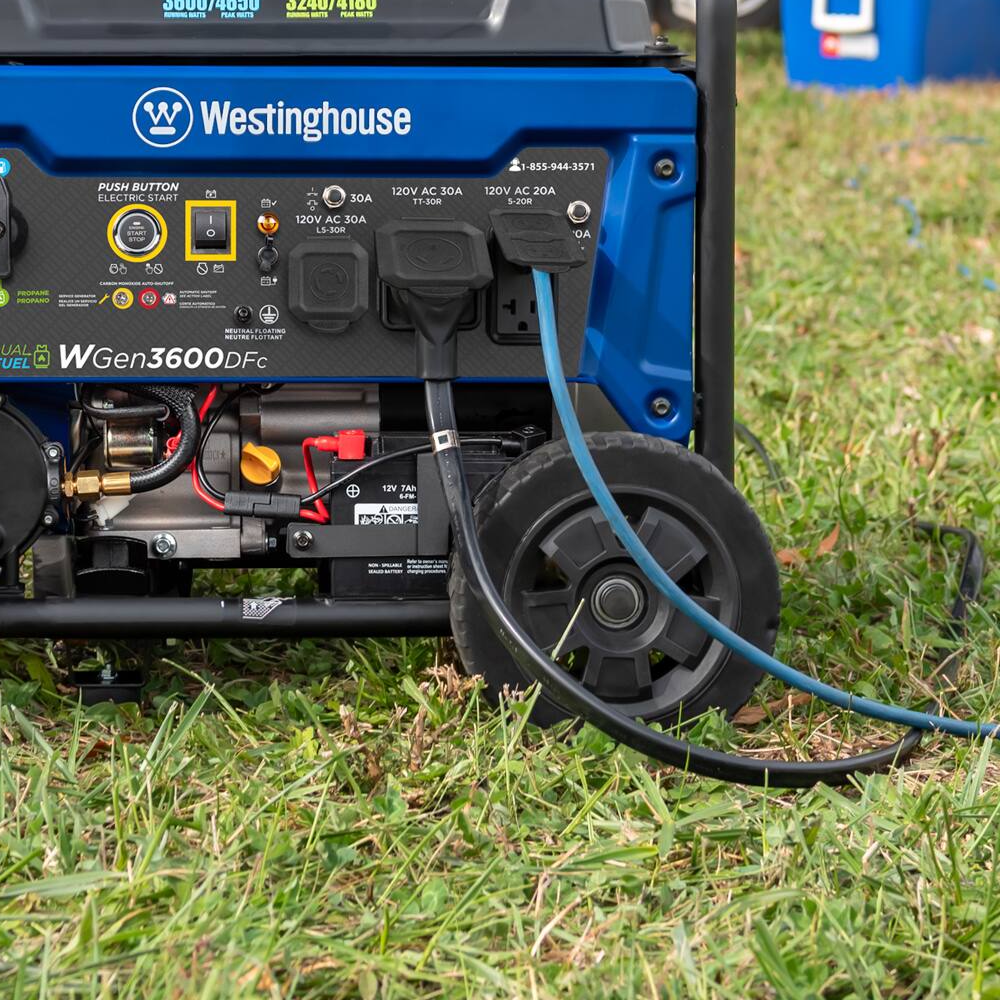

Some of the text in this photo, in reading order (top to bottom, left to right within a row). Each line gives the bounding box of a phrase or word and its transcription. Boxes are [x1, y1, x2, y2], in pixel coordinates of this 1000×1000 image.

[163, 11, 206, 19] RUNNING WATTS
[221, 11, 255, 19] PEAK WATTS
[199, 100, 412, 142] Westinghouse
[520, 162, 595, 171] 1-855-944-3571
[98, 182, 180, 192] PUSH BUTTON
[391, 186, 463, 196] 120V AC 30A
[484, 186, 556, 196] 120V AC 20A
[98, 193, 179, 202] ELECTRIC START
[350, 193, 373, 203] 30A
[412, 198, 442, 206] TT-30R
[295, 215, 367, 224] 120V AC 30A
[571, 229, 592, 239] 0A
[17, 289, 50, 297] PROPANE
[59, 344, 268, 369] WGen3600DFc
[382, 484, 417, 492] 12V 7Ah
